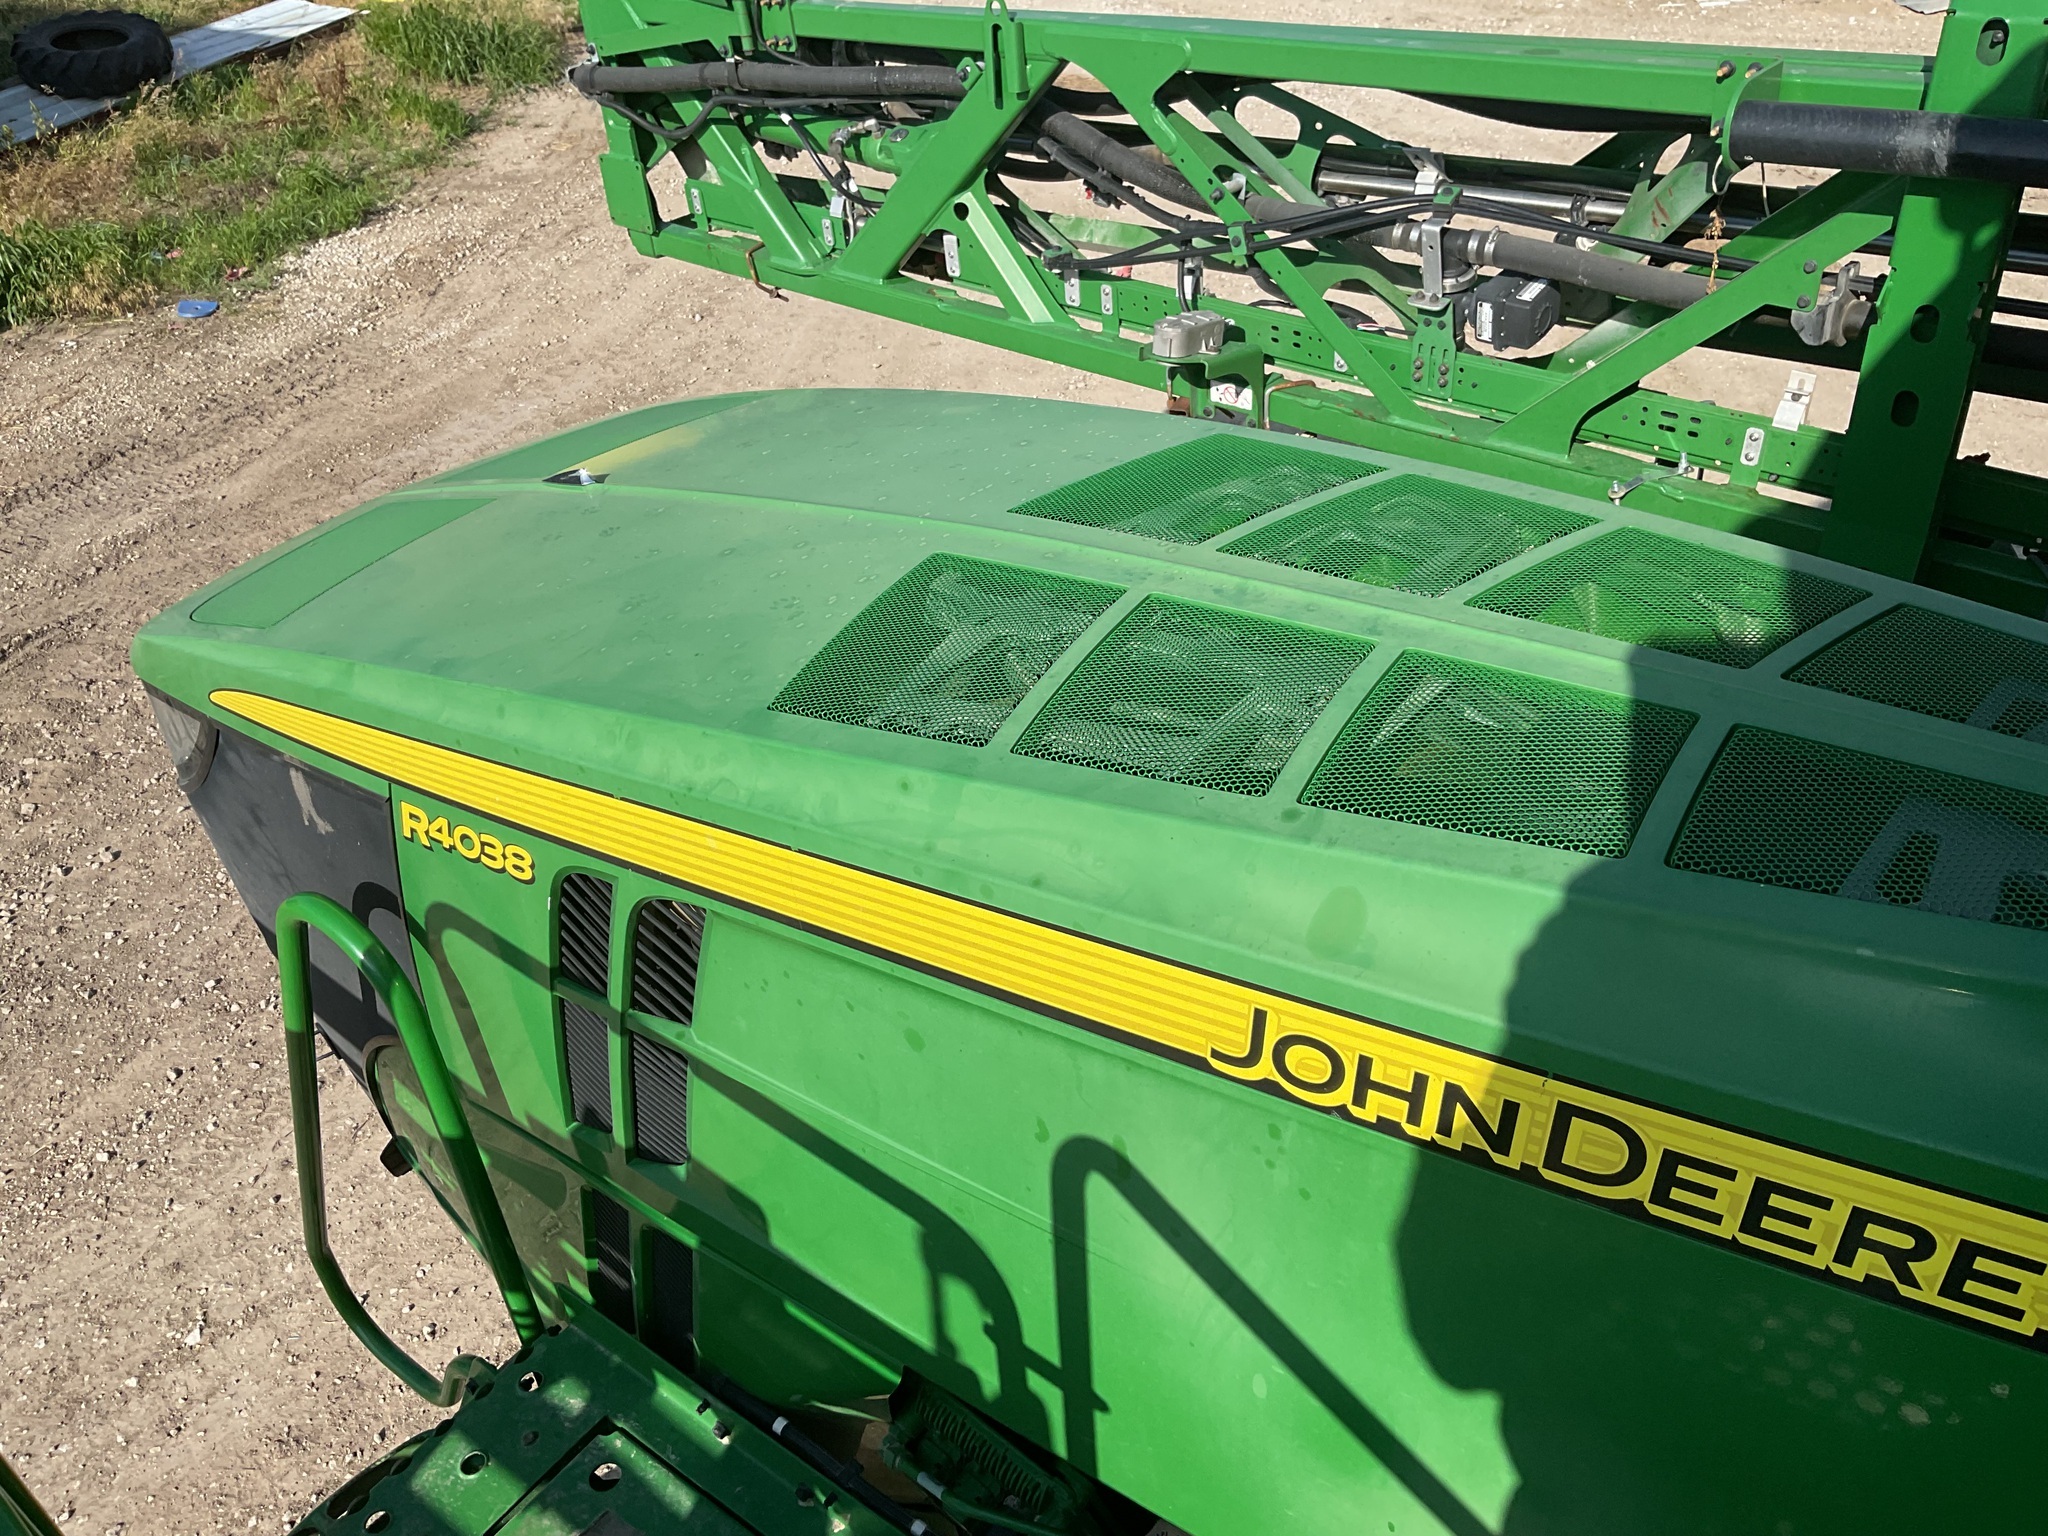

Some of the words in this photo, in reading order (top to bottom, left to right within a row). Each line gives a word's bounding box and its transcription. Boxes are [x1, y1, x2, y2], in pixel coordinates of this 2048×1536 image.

[401, 800, 535, 884] R4038
[1208, 1005, 1522, 1159] JOHN
[1542, 1098, 2048, 1323] DEERE
